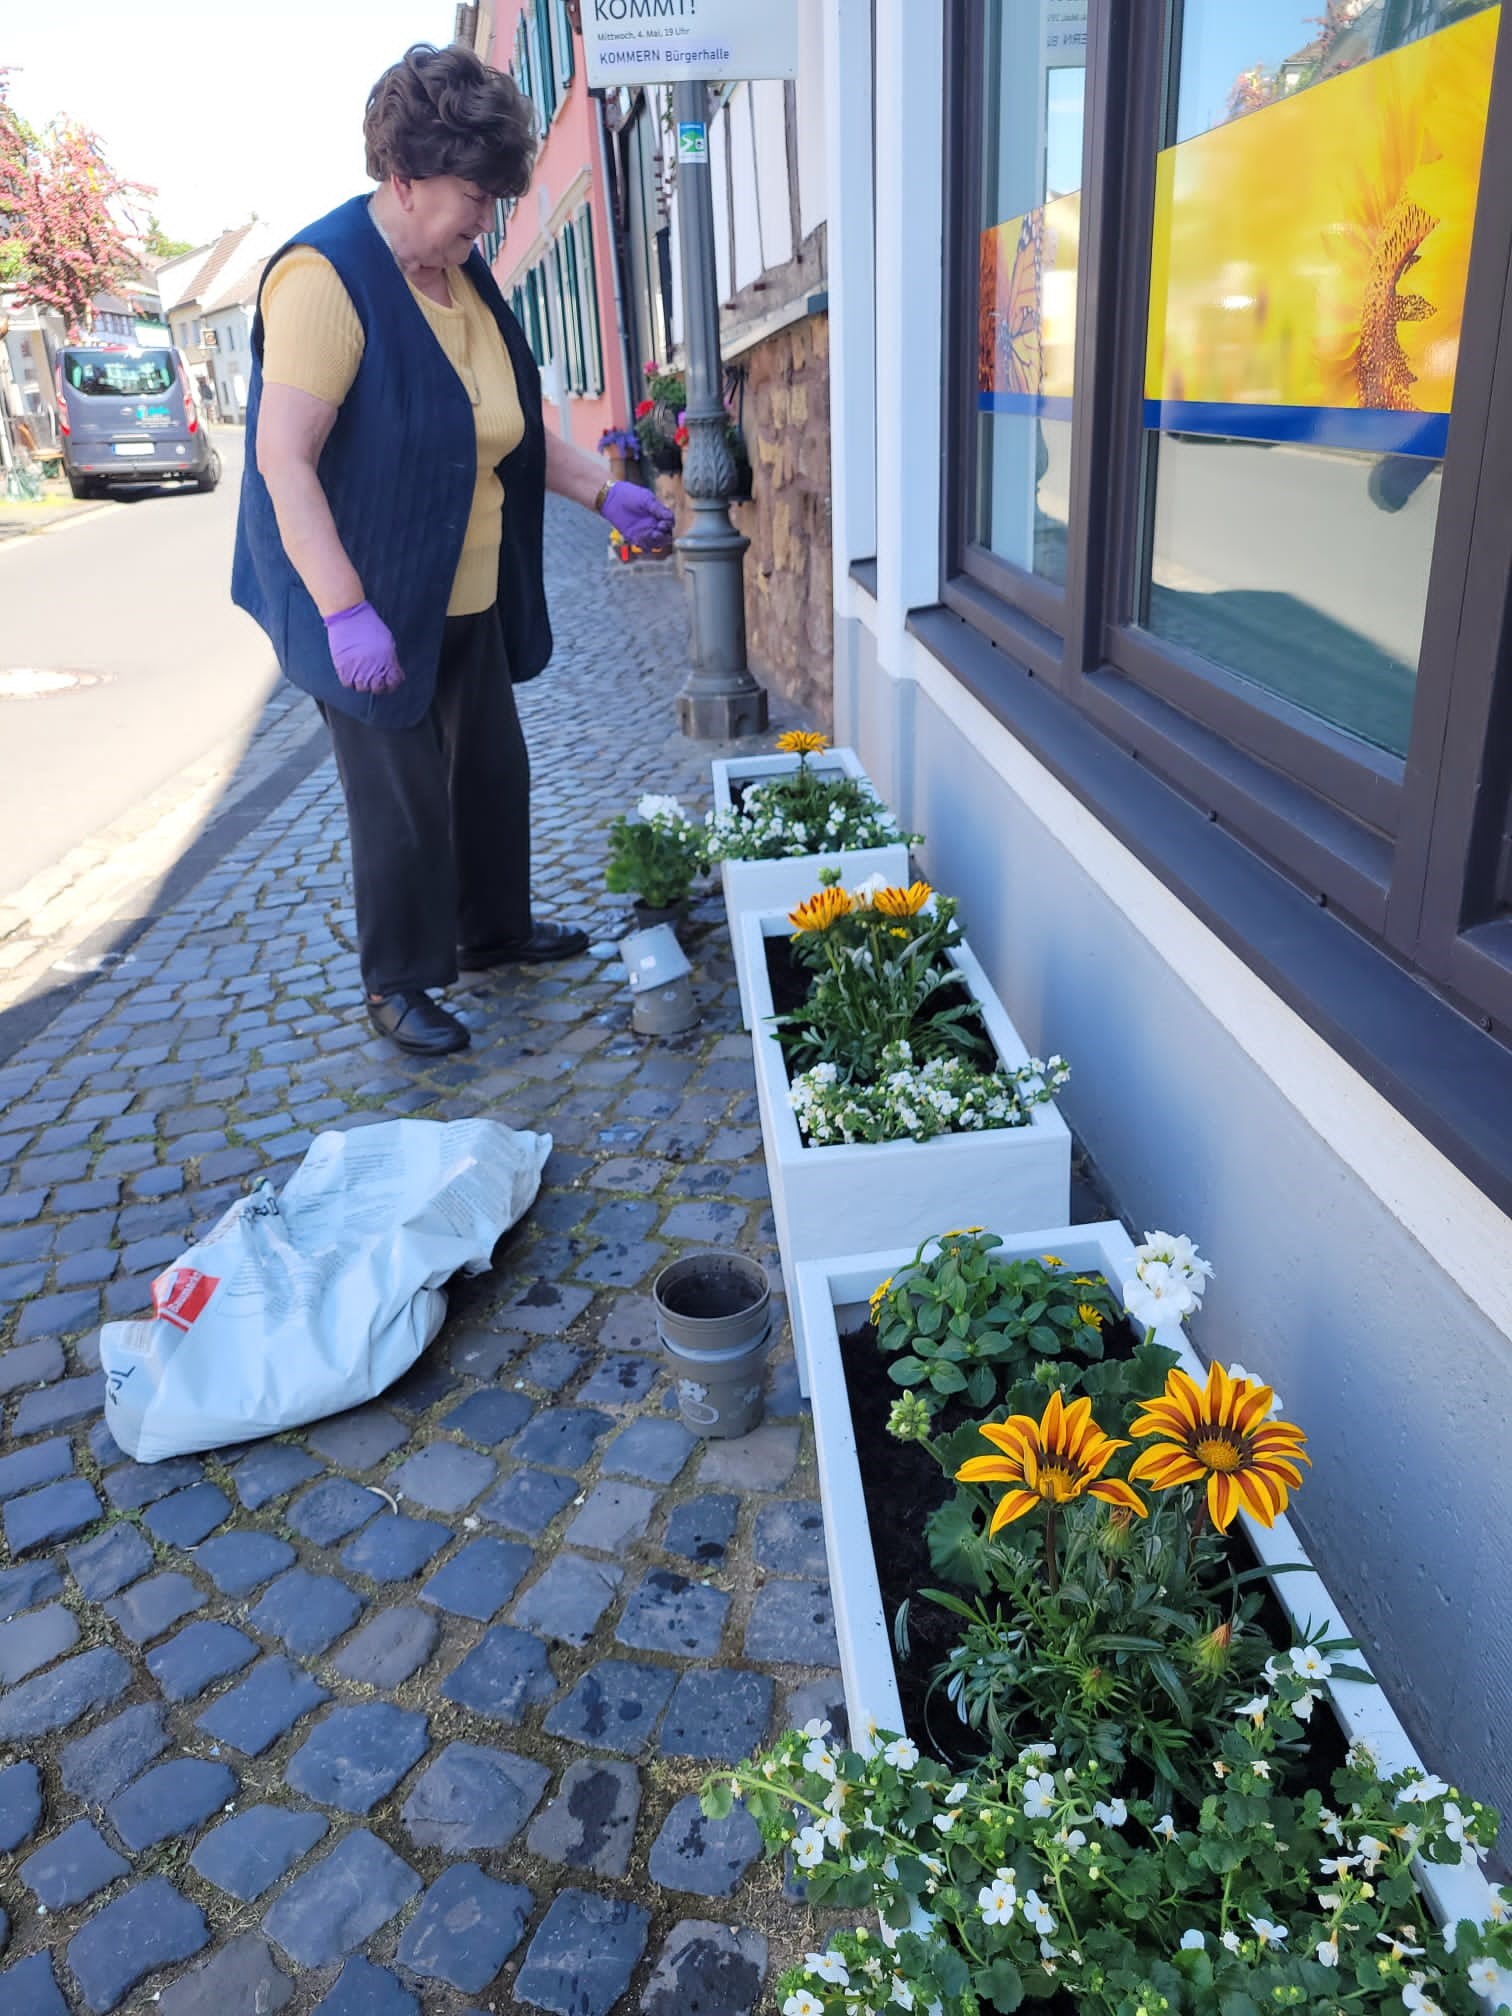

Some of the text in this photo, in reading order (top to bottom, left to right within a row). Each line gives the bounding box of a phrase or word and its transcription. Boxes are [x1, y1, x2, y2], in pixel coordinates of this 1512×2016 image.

[595, 0, 696, 21] KOMMT!
[675, 26, 690, 36] Uhr
[600, 48, 730, 65] KOMMERN Bürgerhalle
